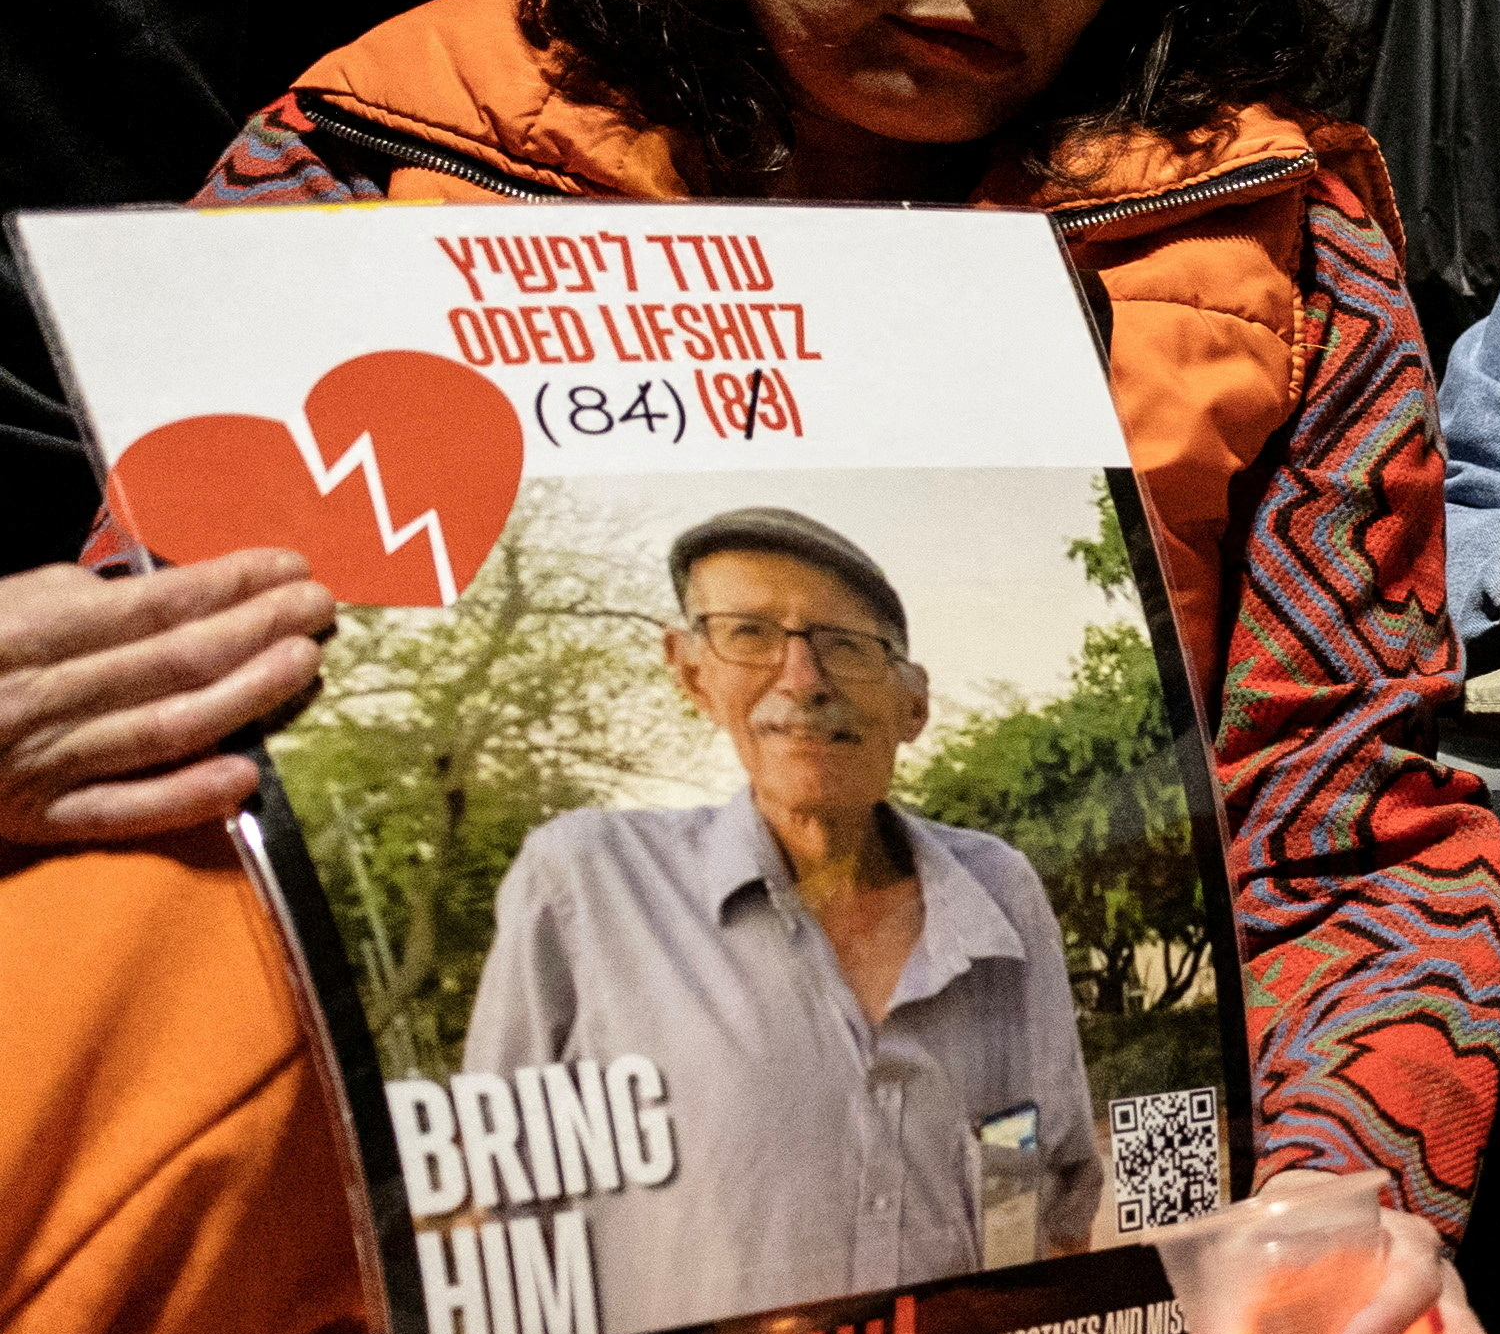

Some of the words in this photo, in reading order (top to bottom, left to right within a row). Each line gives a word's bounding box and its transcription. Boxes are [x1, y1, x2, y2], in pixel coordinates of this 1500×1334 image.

[434, 231, 638, 302] ליפשיץ
[645, 235, 774, 293] עודד
[447, 305, 595, 367] ODED
[598, 303, 823, 362] LIFSHITZ
[535, 379, 685, 447] (84)
[384, 1054, 677, 1218] BRING
